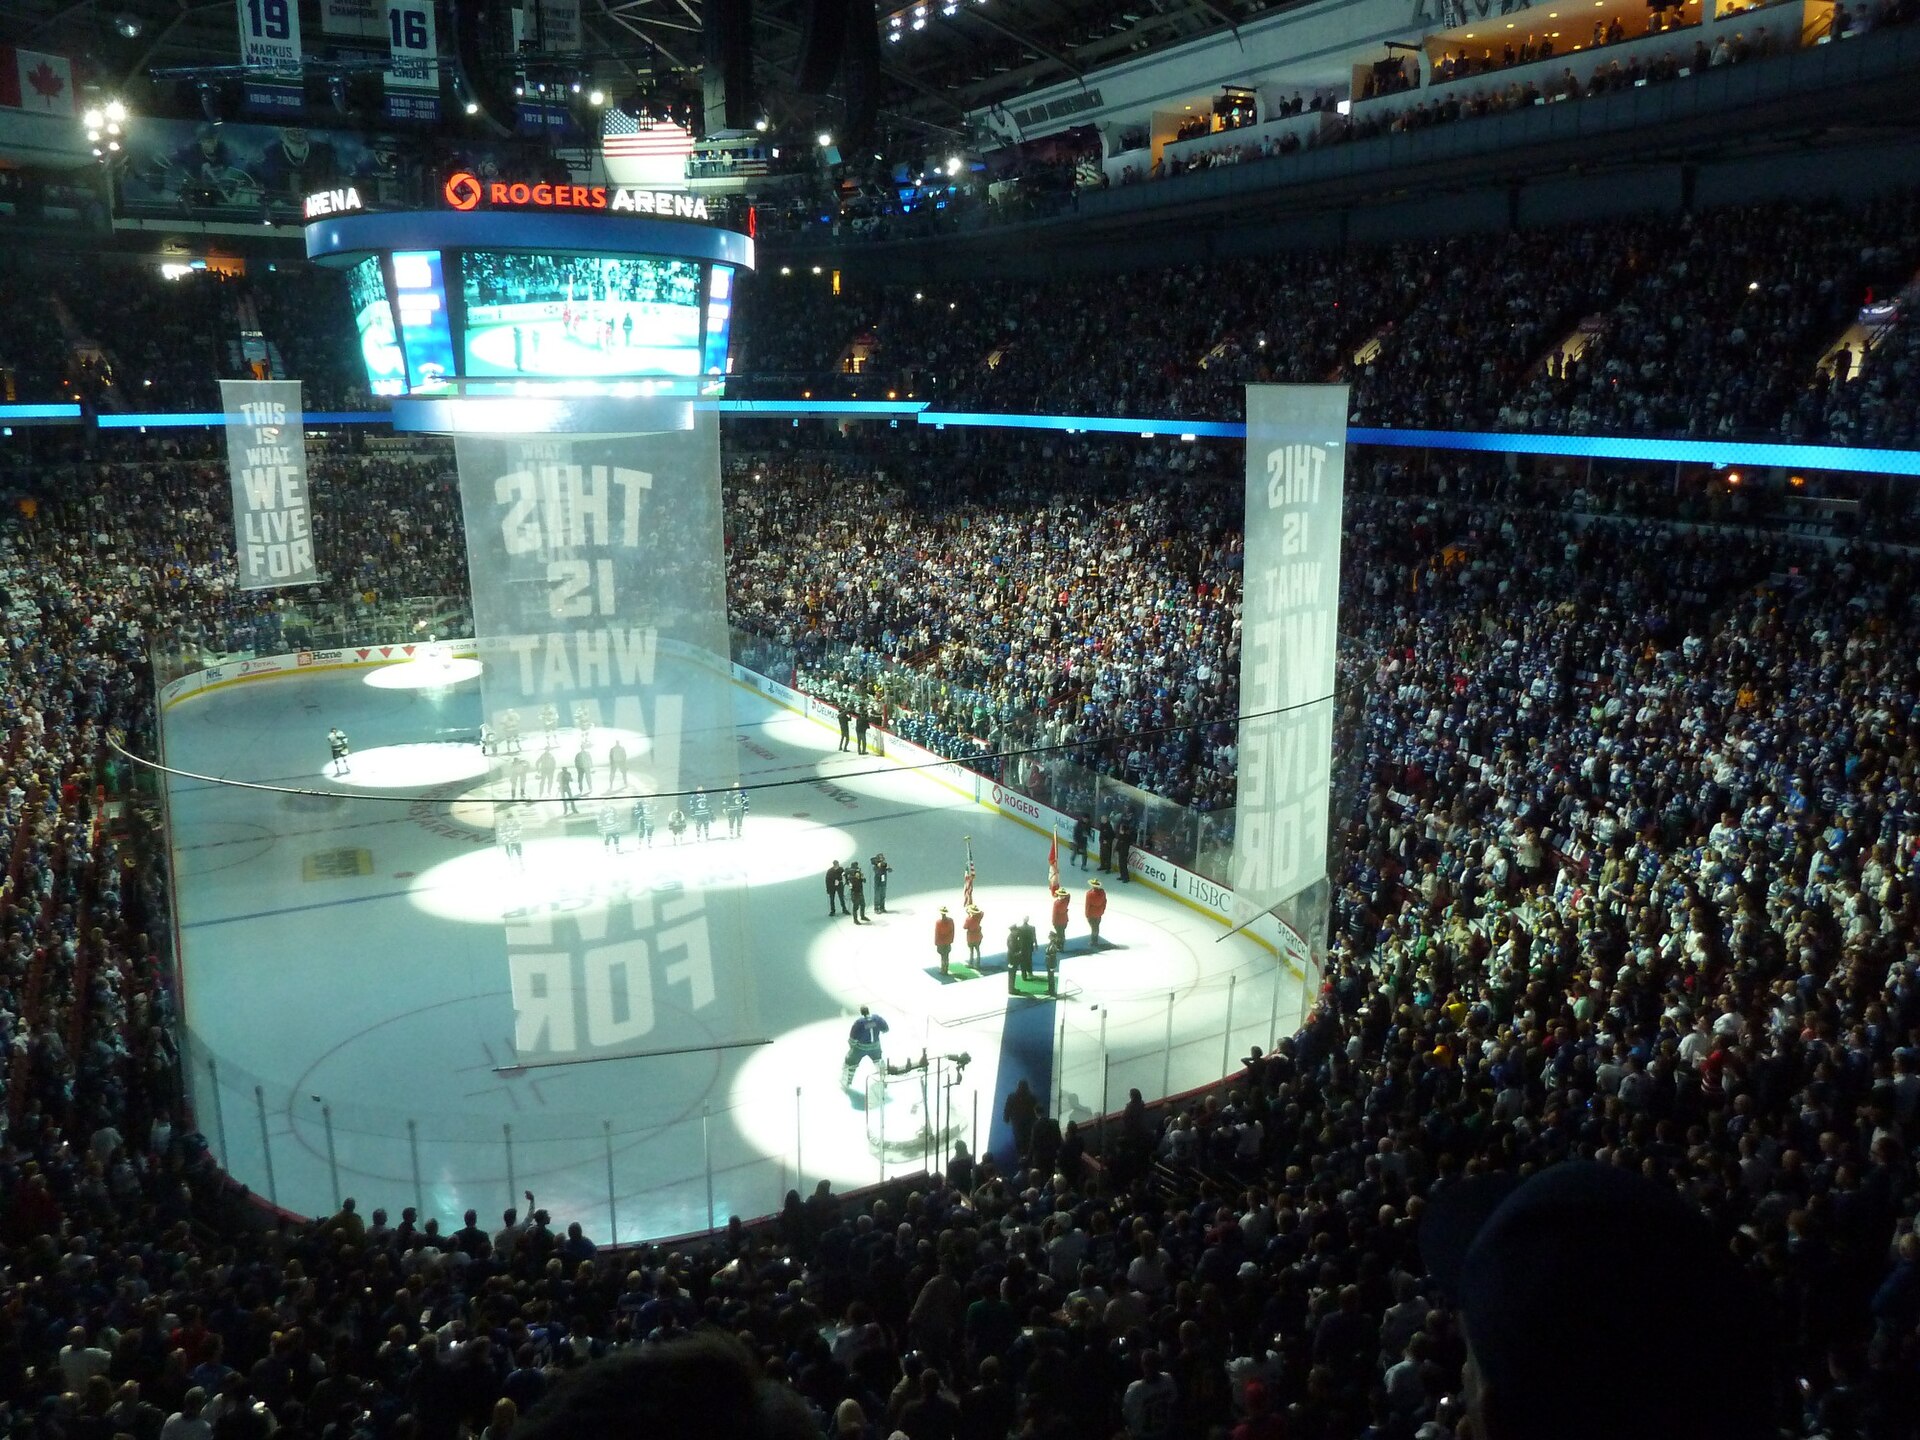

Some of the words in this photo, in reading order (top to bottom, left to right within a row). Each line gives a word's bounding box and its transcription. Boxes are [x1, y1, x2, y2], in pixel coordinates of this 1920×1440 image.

[248, 0, 290, 39] 19
[388, 8, 428, 49] 16
[250, 43, 293, 58] MARKUS
[306, 187, 363, 218] ARENA
[490, 183, 607, 209] ROGERS
[611, 188, 710, 220] ARENA
[240, 402, 286, 426] THIS
[256, 427, 279, 445] IS
[246, 446, 290, 466] WHAT
[242, 466, 304, 511] WE
[244, 508, 309, 544] LIVE
[247, 537, 314, 579] FOR
[311, 650, 343, 661] Home
[205, 667, 224, 681] NHL
[1004, 793, 1040, 819] ROGERS
[1145, 864, 1167, 883] zero
[1188, 875, 1232, 912] HSBC
